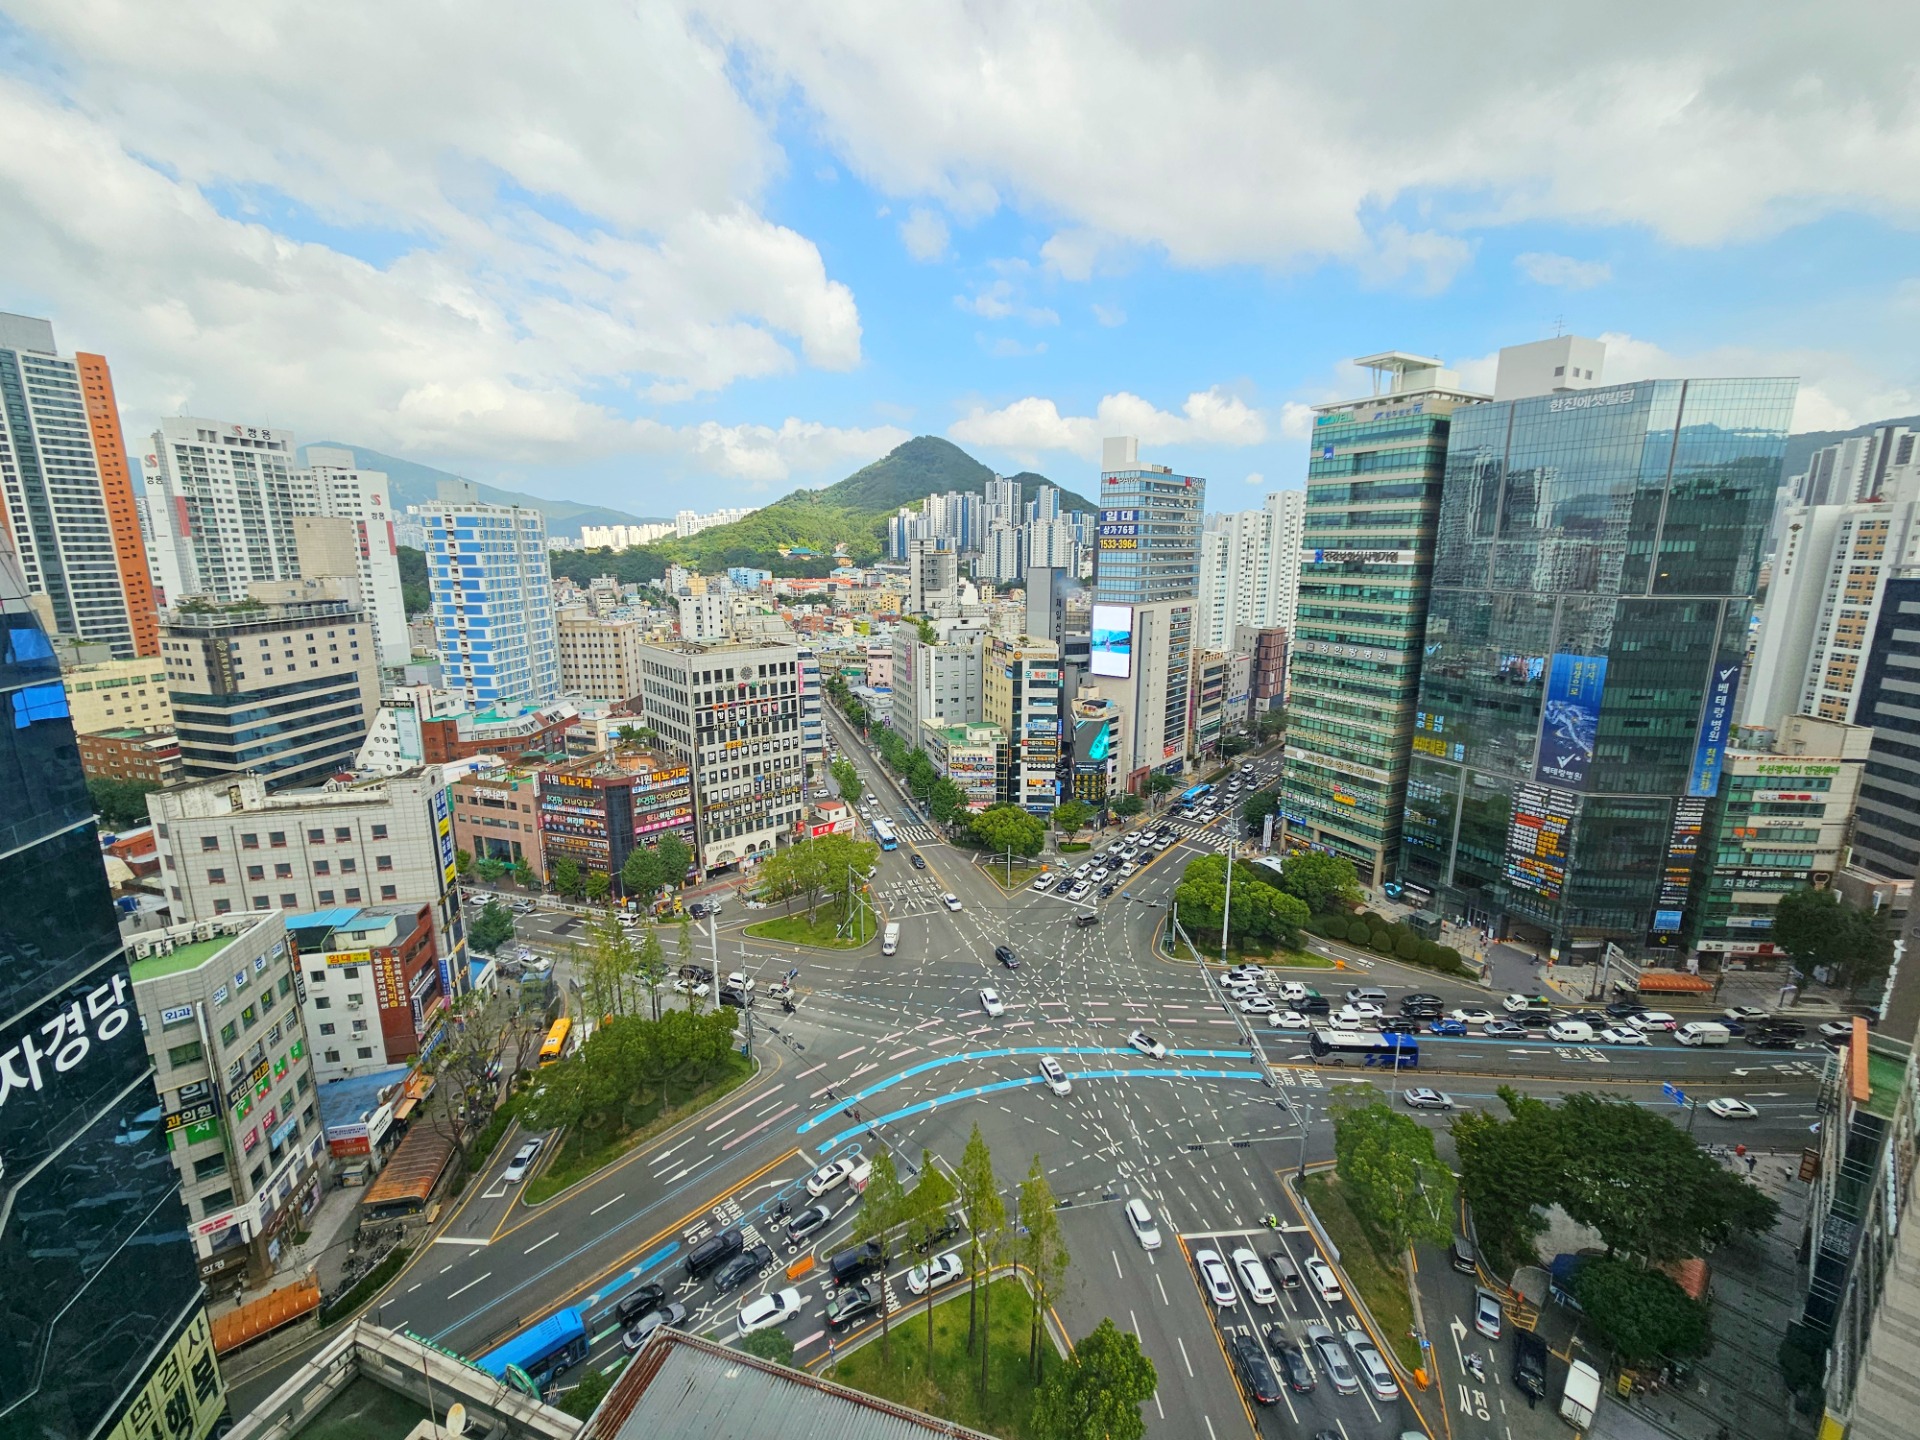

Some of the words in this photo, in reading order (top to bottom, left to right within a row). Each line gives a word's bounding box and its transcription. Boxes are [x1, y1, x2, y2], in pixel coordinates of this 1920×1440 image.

[1550, 389, 1635, 412] 한진에셋빌딩
[247, 428, 271, 440] 쌍용
[1105, 510, 1133, 522] 임대
[1100, 539, 1137, 549] 1533-3964
[1570, 662, 1583, 696] 일상으로
[1708, 683, 1730, 741] 베테랑병원
[1542, 766, 1582, 780] 베테랑병원
[1757, 764, 1801, 775] 부산광역시
[1805, 765, 1840, 776] 인권센터
[328, 954, 351, 964] 임대
[164, 1006, 192, 1021] 외과
[0, 974, 129, 1106] 자경당
